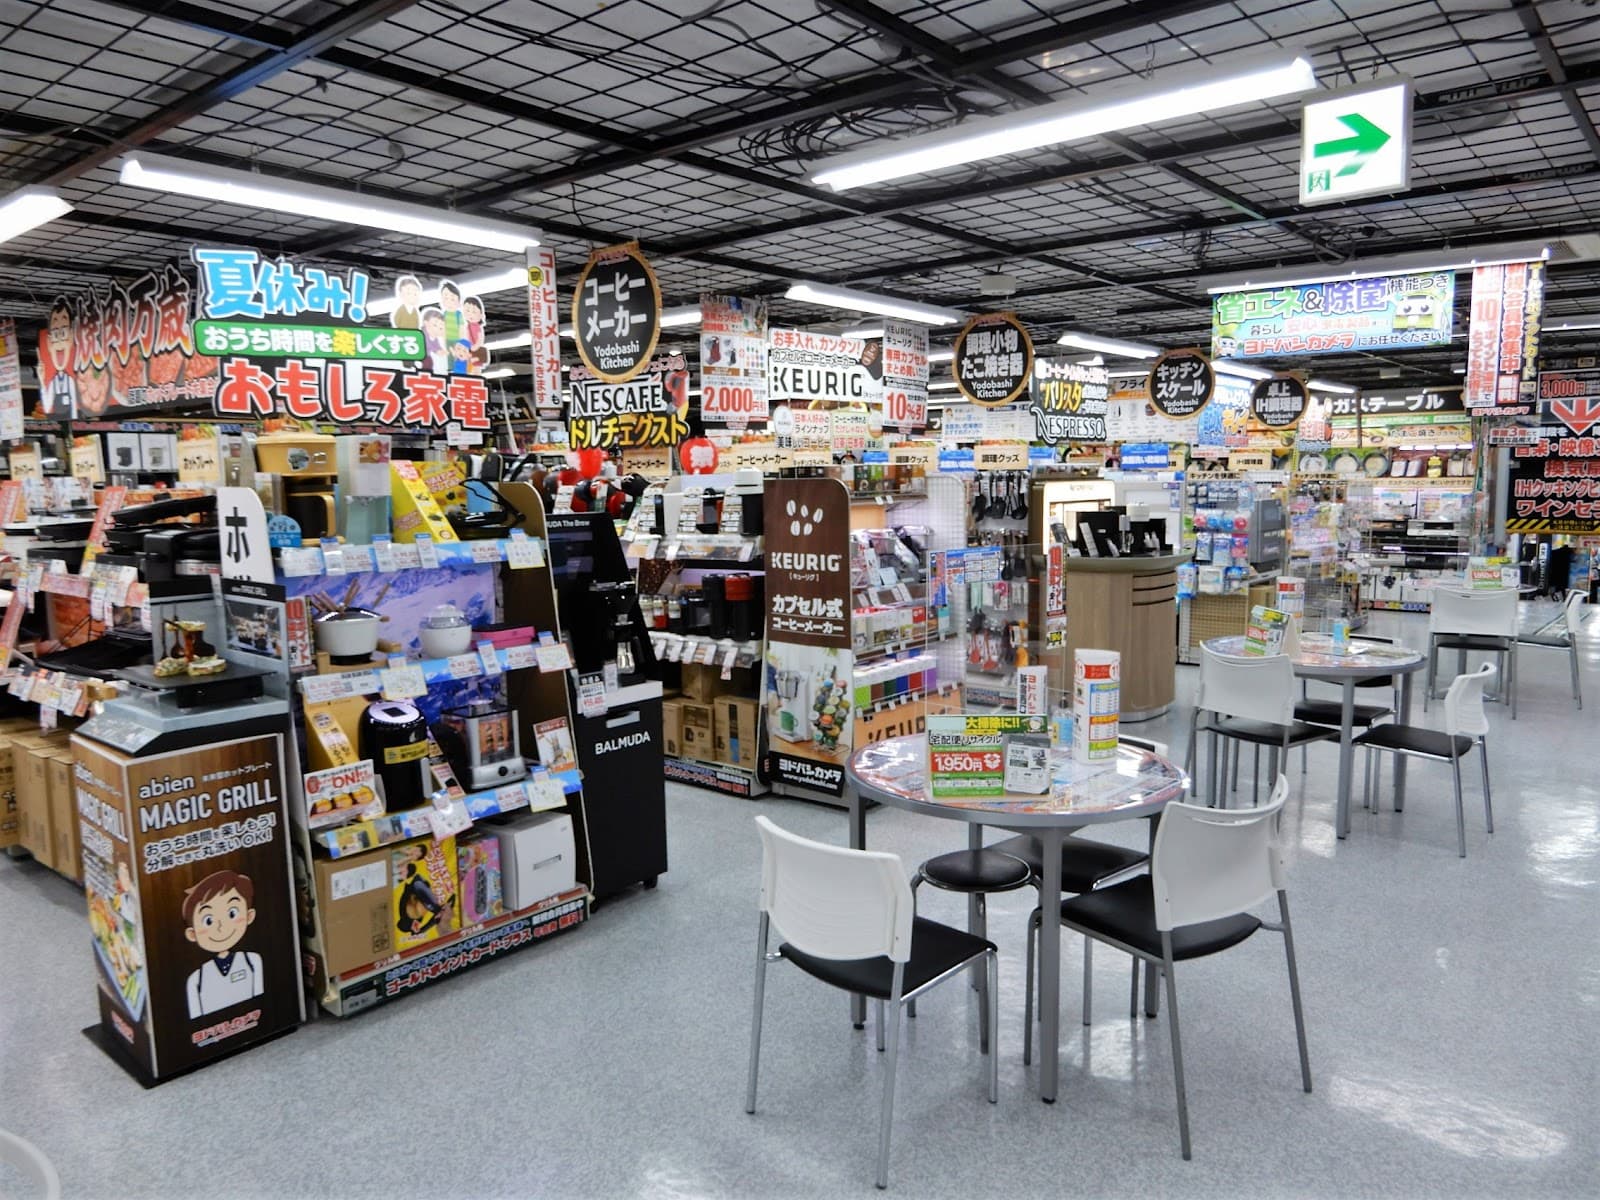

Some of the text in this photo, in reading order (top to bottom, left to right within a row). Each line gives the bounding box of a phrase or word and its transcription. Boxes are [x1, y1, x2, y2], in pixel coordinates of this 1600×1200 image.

[197, 246, 368, 321] 夏休み!
[585, 271, 646, 307] コーヒー
[585, 305, 648, 342] メーカー
[203, 324, 420, 356] おうち時間を楽しくする
[594, 340, 640, 358] Yodobashi
[966, 329, 1019, 356] 調理小物
[600, 355, 634, 370] Kitchen
[961, 352, 1024, 380] たこ焼き器
[1156, 360, 1205, 382] キッチン
[219, 358, 491, 429] おもしろ家電
[774, 366, 863, 397] KEURIG
[1156, 379, 1206, 400] スケール
[737, 454, 788, 466] コーヒーメーカー
[771, 551, 841, 573] KEURIG
[772, 594, 844, 619] カプセル式
[772, 616, 845, 635] コーヒーメーカー
[594, 730, 651, 755] BALMUDA
[779, 757, 842, 784] ヨドバシカメラ
[139, 776, 195, 799] abien
[140, 792, 213, 833] MAGIC
[217, 778, 278, 814] GRILL
